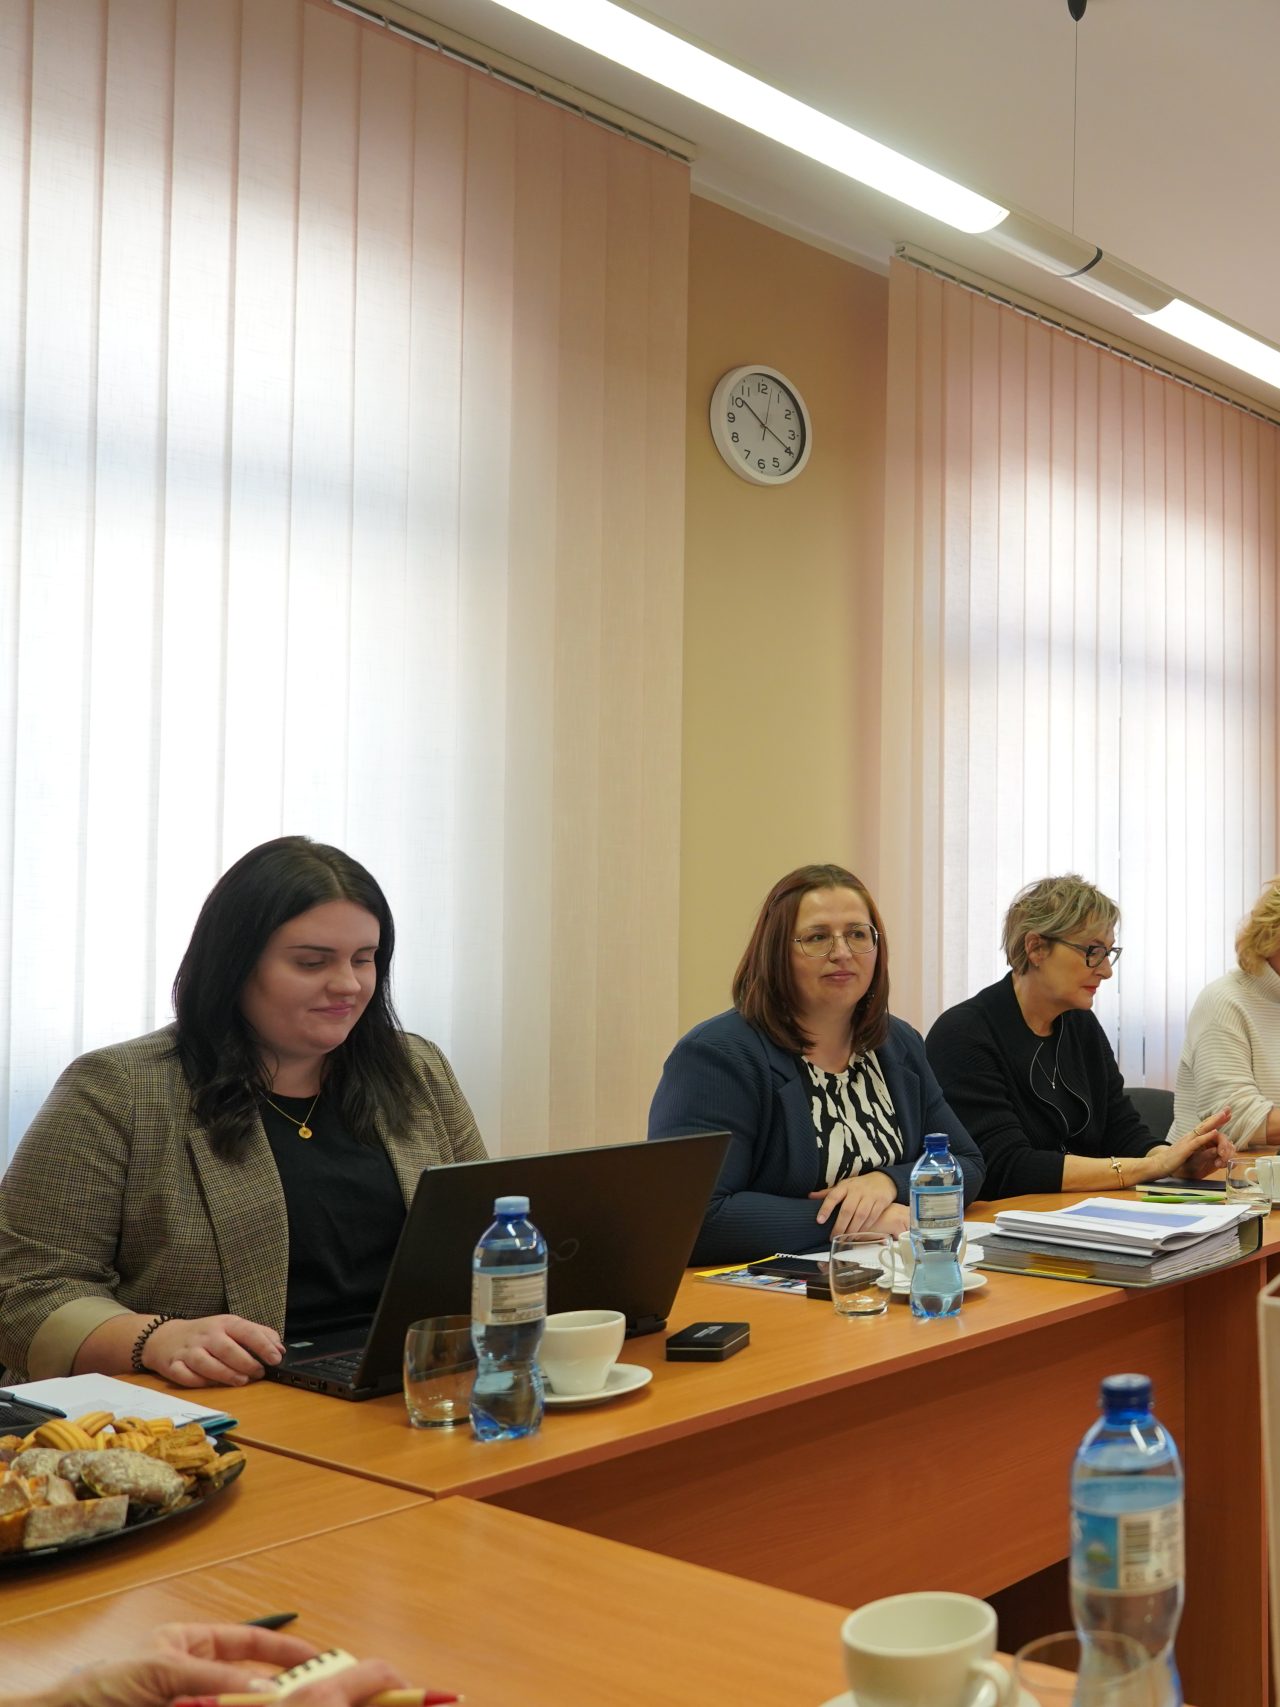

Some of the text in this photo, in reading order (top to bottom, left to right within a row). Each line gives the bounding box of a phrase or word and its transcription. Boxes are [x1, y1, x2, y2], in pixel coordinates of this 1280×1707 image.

[742, 385, 750, 397] 11
[758, 383, 768, 395] 12
[732, 396, 744, 408] 10
[727, 412, 736, 423] 9
[784, 409, 792, 420] 2
[732, 432, 739, 442] 8
[788, 430, 796, 440] 3
[744, 449, 751, 460] 7
[784, 446, 792, 456] 4
[758, 459, 766, 469] 6
[772, 458, 780, 468] 5
